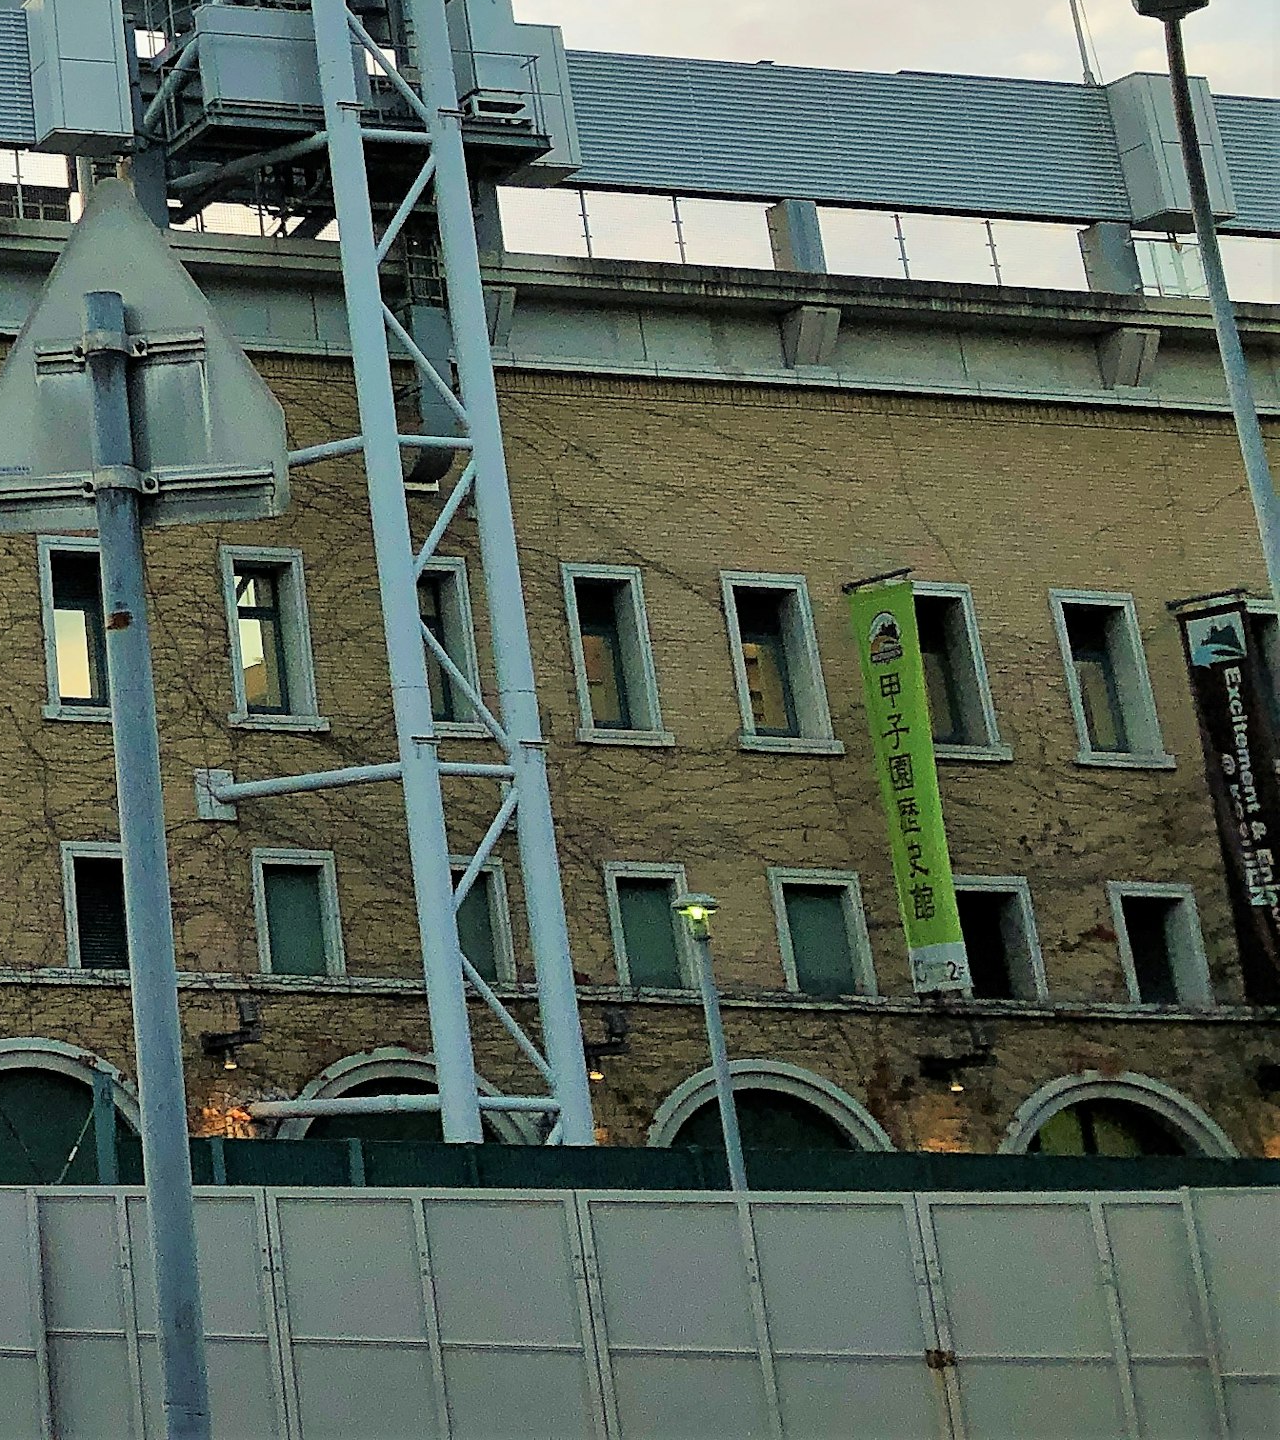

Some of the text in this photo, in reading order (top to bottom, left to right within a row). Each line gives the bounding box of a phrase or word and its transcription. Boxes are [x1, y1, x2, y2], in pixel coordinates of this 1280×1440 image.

[879, 672, 936, 921] 甲子園歴史館
[1224, 665, 1261, 813] Excitement
